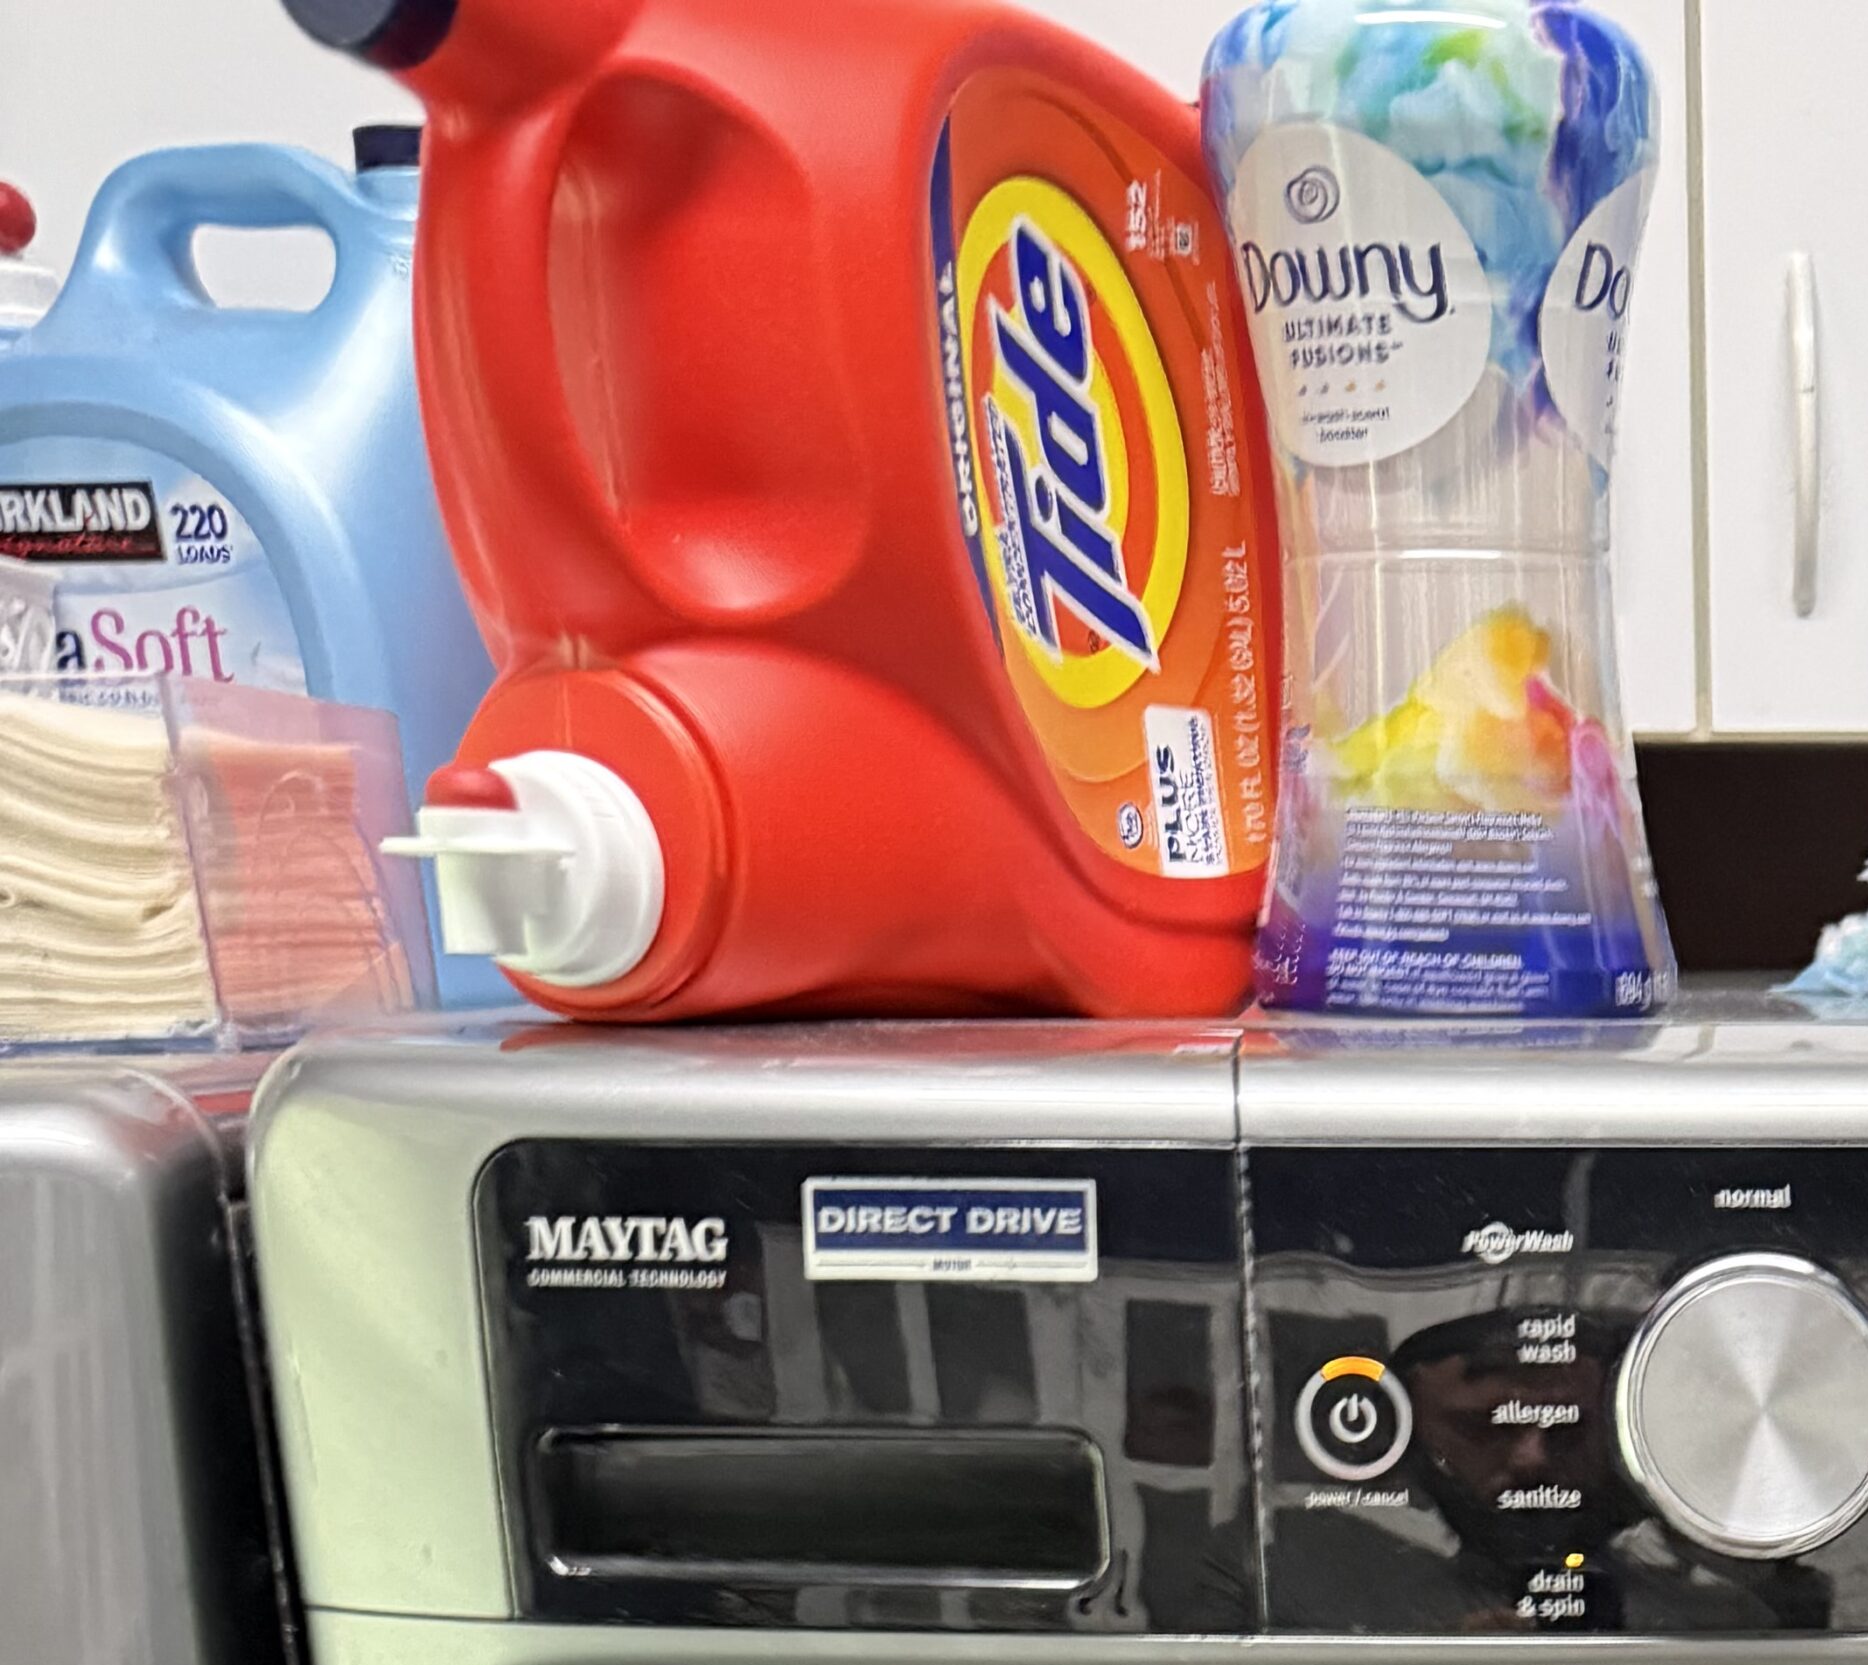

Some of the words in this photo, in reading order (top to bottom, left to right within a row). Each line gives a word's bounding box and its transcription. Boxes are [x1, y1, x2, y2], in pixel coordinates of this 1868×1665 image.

[1126, 179, 1148, 252] 152
[1240, 240, 1449, 324] Downy
[1284, 313, 1392, 341] ULTIMATE
[1290, 343, 1391, 370] FUSIONS
[939, 262, 981, 537] ORIGINAL
[986, 216, 1160, 672] Tide
[172, 503, 228, 541] 220
[177, 544, 233, 564] LOADS
[1234, 734, 1260, 767] OZ
[1155, 745, 1187, 862] PLUS
[1714, 1184, 1791, 1209] normal
[817, 1206, 958, 1235] DIRECT
[966, 1206, 1084, 1235] DRIVE
[526, 1215, 728, 1262] MAYTAG
[1462, 1226, 1575, 1257] PowerWash
[527, 1270, 626, 1288] COMMERCIAL
[628, 1270, 727, 1288] TECHNOLOGY
[1518, 1314, 1576, 1340] rapid
[1517, 1341, 1577, 1364] wash
[1492, 1400, 1580, 1428] allergen
[1497, 1484, 1582, 1509] sanitize
[1528, 1569, 1584, 1592] drain
[1517, 1596, 1536, 1617] &
[1538, 1594, 1586, 1621] spin
